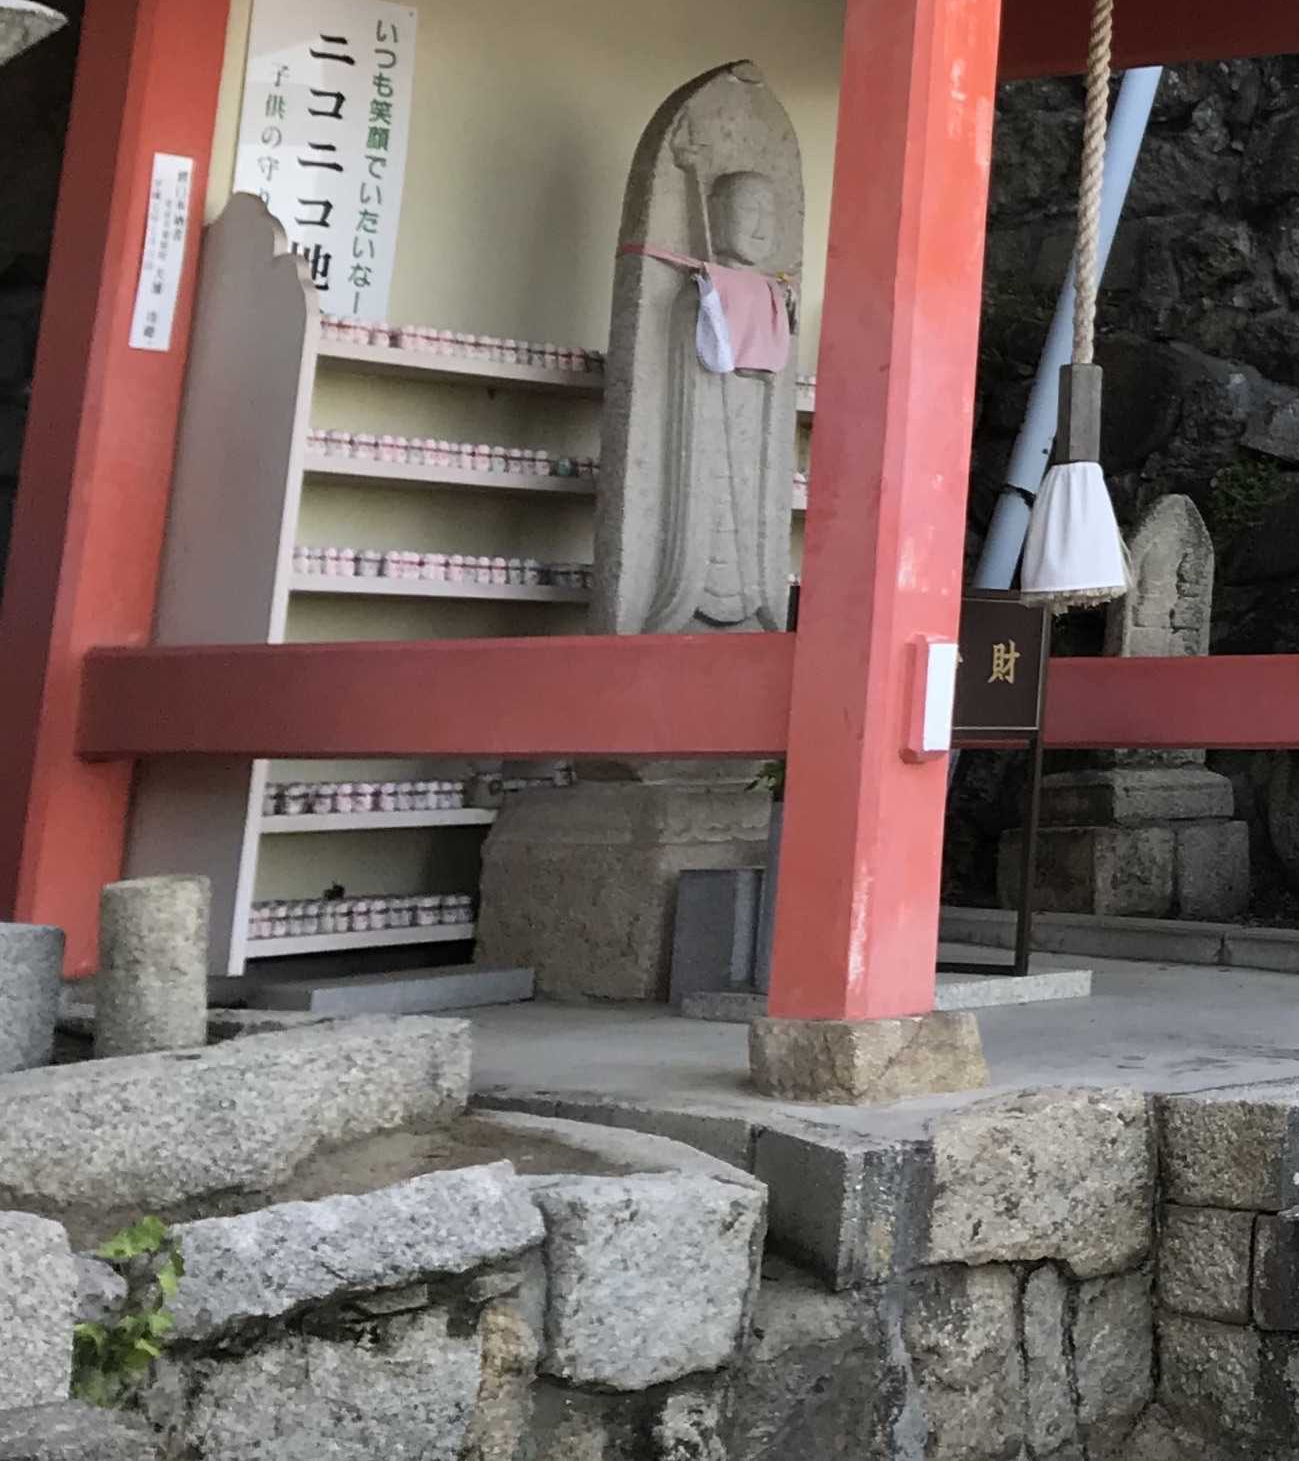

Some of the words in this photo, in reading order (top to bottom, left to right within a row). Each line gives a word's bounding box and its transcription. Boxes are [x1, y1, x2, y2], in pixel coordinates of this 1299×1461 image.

[348, 19, 399, 315] いつも笑顔でいたいなー
